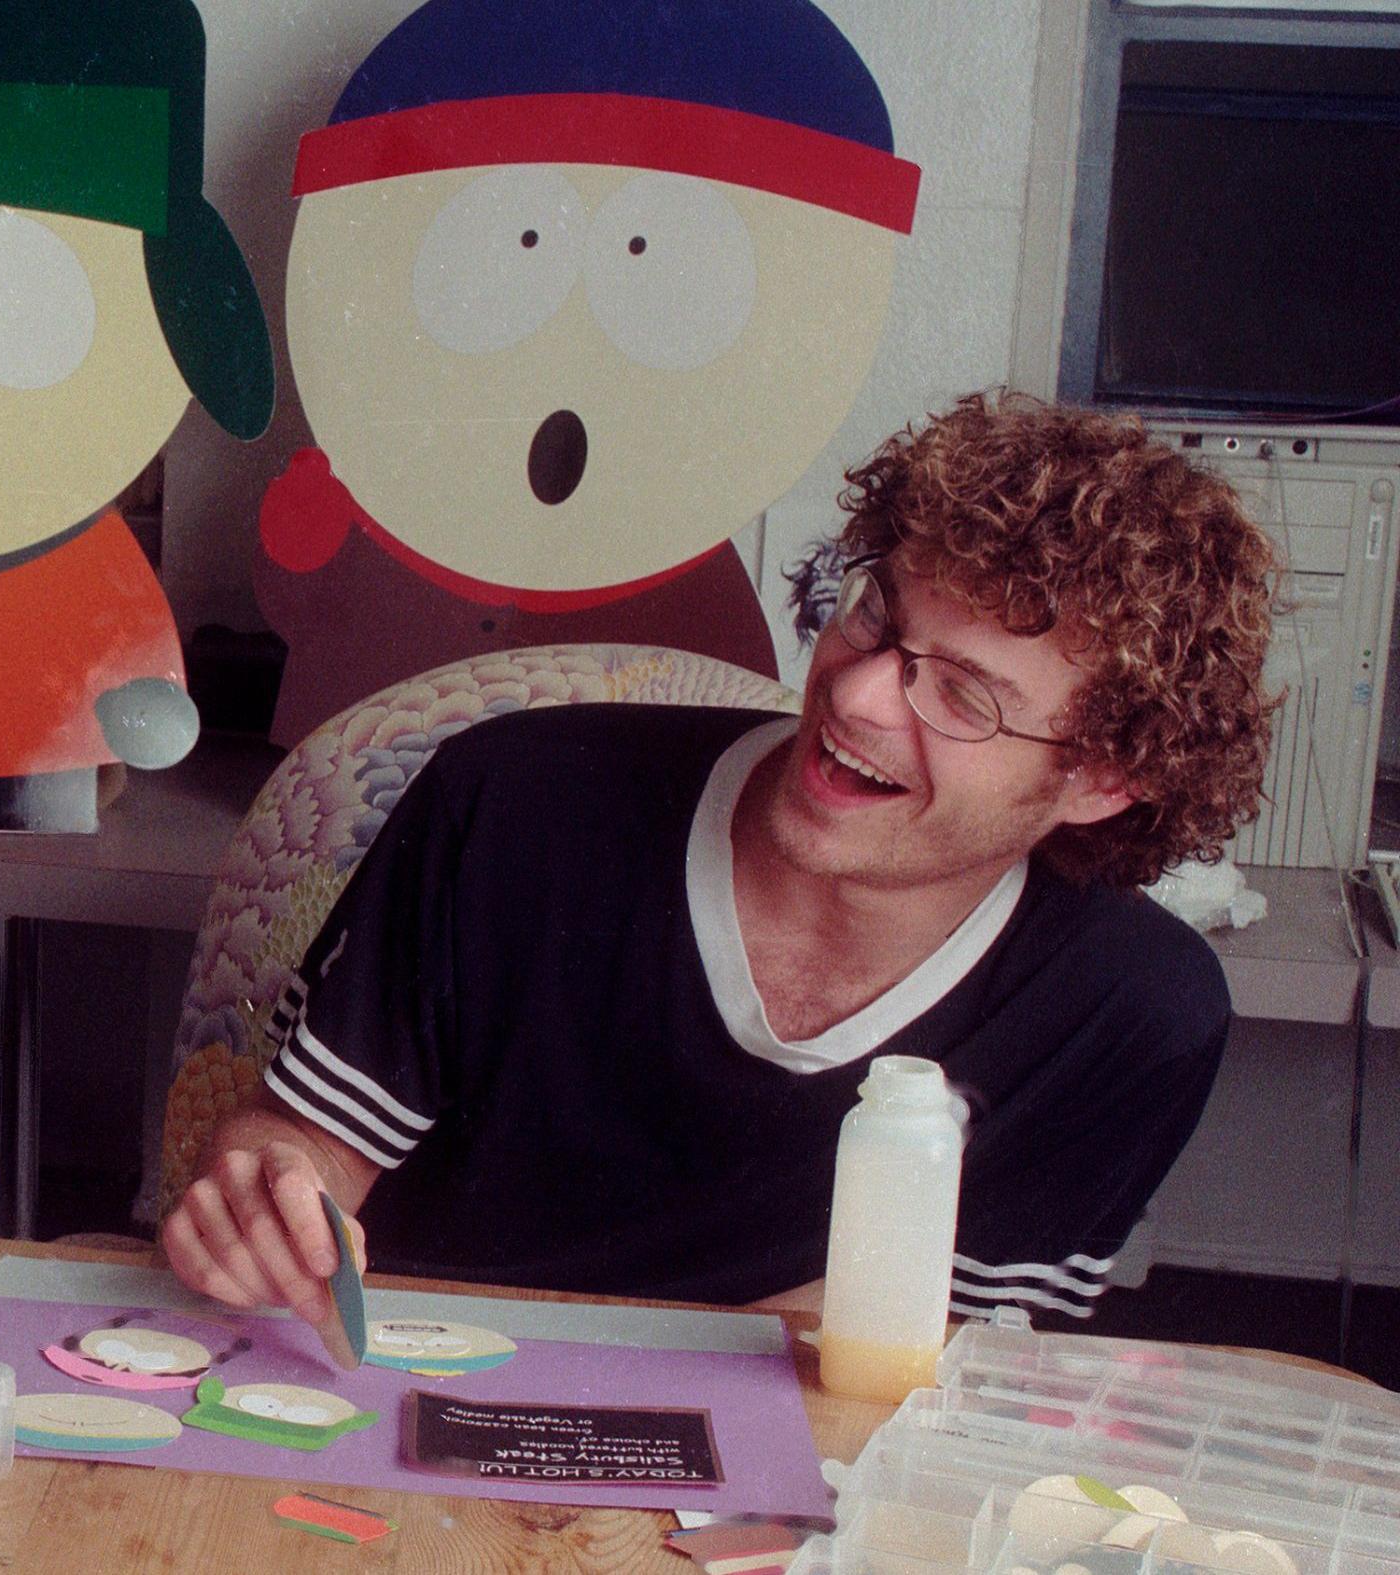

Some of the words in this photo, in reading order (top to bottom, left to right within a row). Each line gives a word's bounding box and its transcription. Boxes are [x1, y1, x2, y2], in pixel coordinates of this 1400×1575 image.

[514, 1424, 546, 1432] bean
[551, 1426, 593, 1434] Green
[519, 1441, 575, 1449] noodles
[602, 1437, 650, 1445] choice
[580, 1444, 643, 1453] buttered
[495, 1449, 567, 1462] Steak
[575, 1451, 684, 1465] Salisbury
[524, 1466, 579, 1477] HOT
[588, 1467, 703, 1478] TODAY'S
